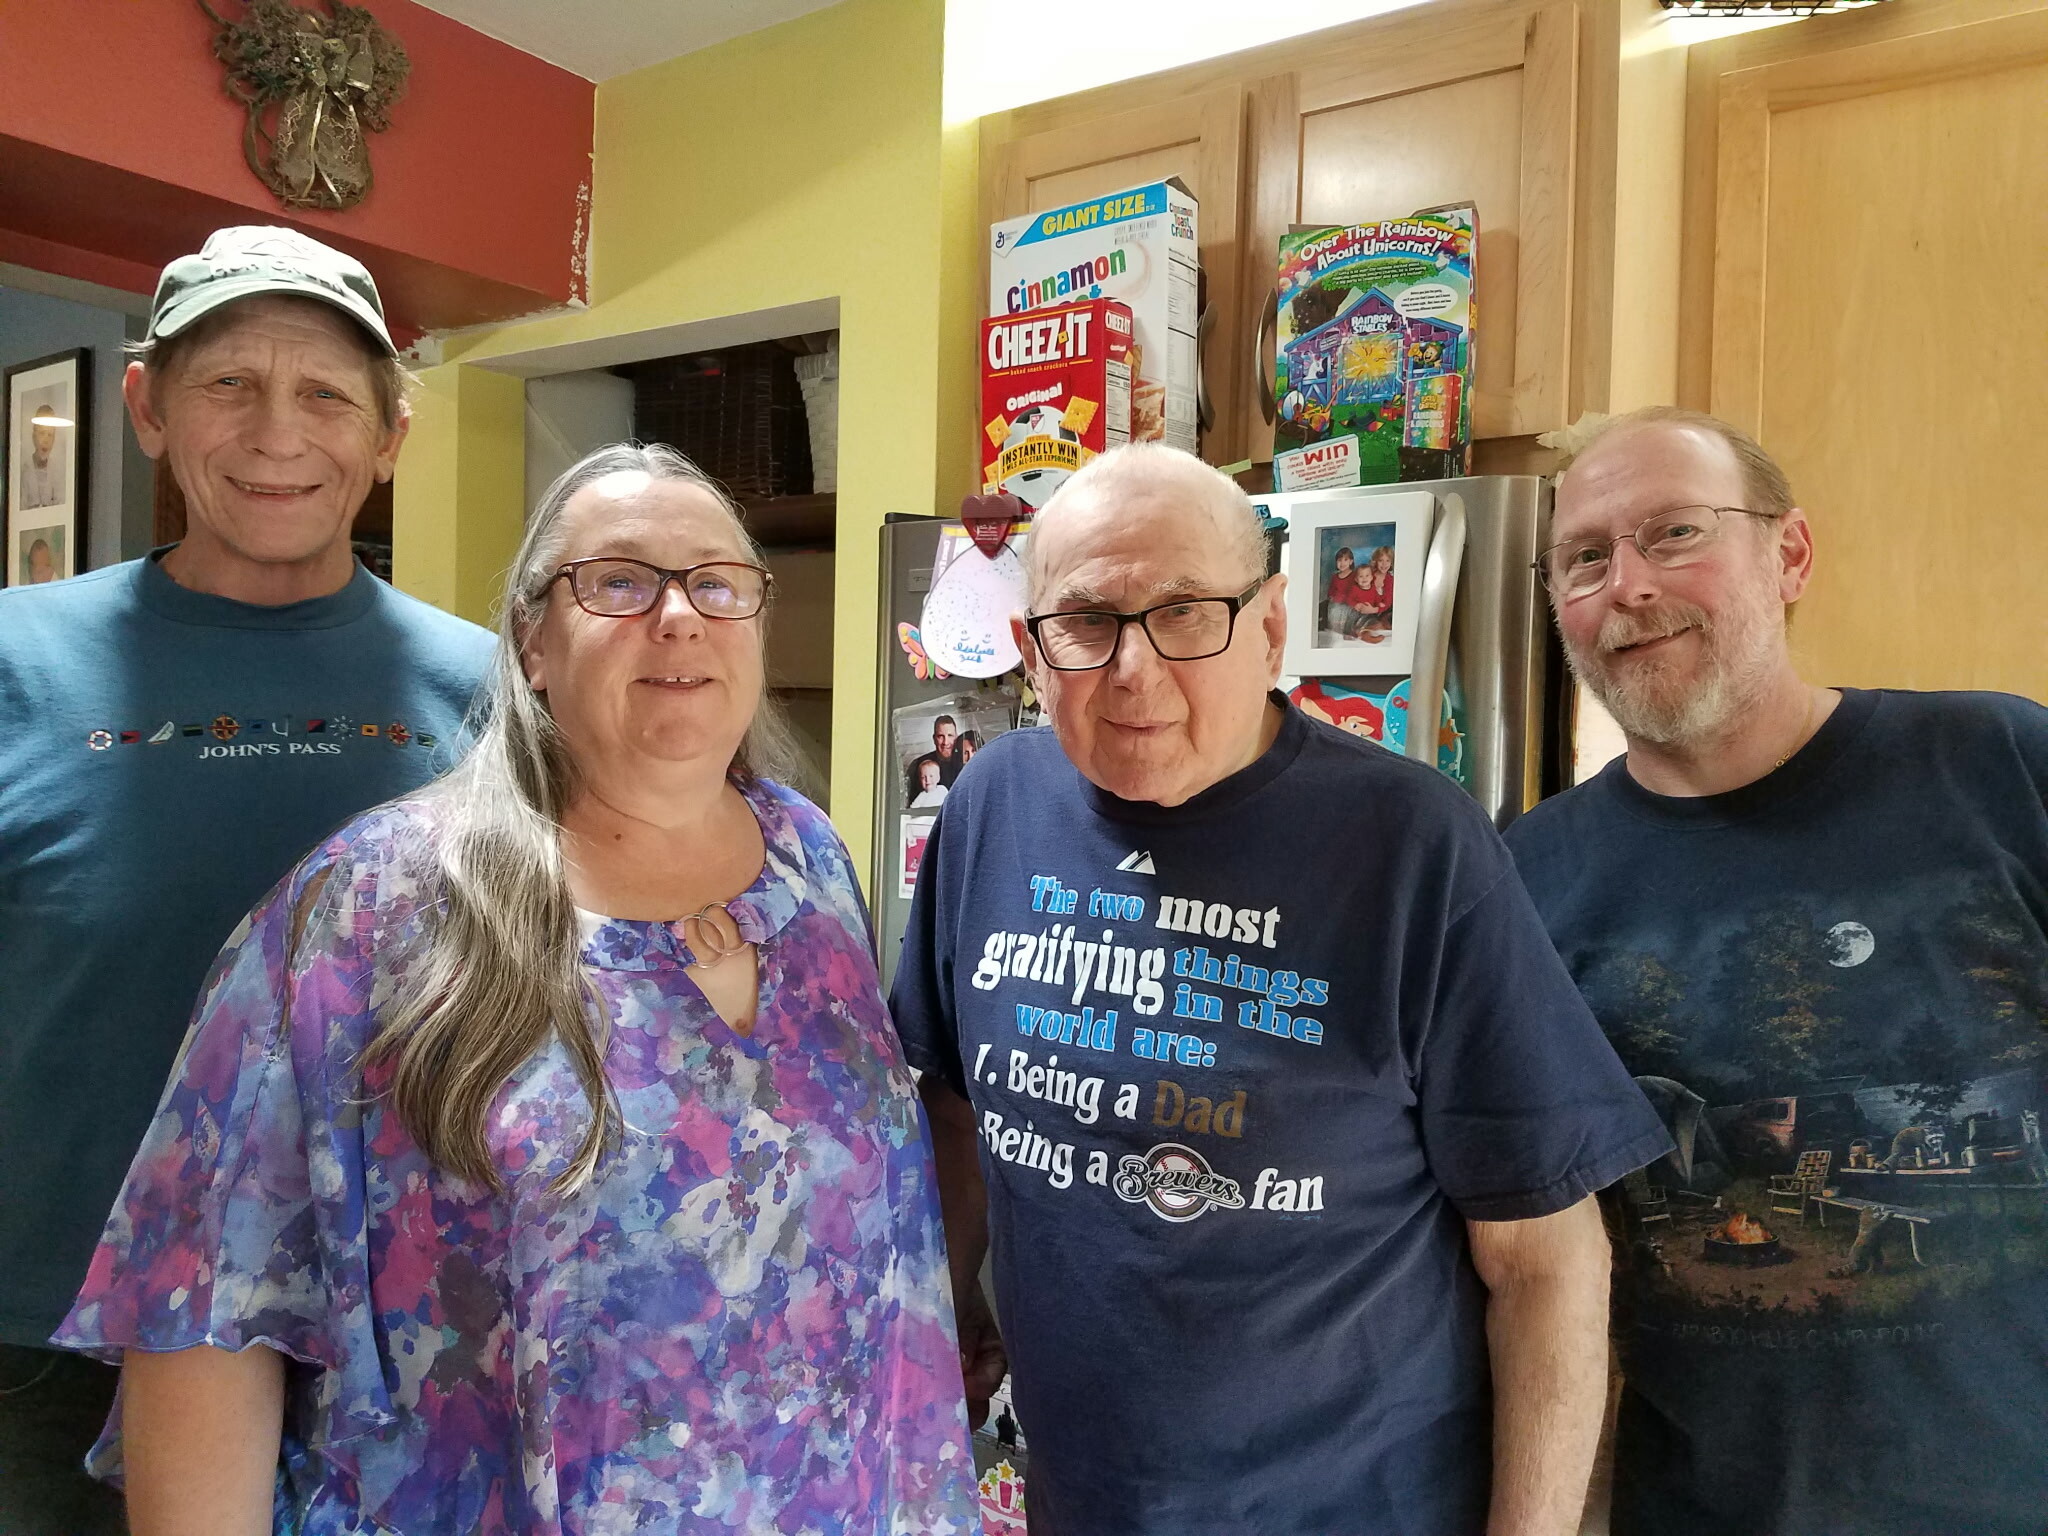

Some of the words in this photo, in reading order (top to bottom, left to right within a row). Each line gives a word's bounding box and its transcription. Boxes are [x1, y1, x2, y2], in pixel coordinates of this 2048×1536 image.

[1042, 205, 1100, 235] GIANT
[1103, 193, 1147, 221] SIZE
[1300, 234, 1340, 262] Over
[1344, 225, 1375, 241] The
[1380, 220, 1454, 242] Rainbow
[1007, 248, 1127, 314] Cinnamon
[1317, 243, 1361, 271] About
[1363, 237, 1442, 257] Unicorns!
[1002, 442, 1054, 467] INSTANTLY
[1057, 442, 1078, 459] WIN
[199, 743, 281, 760] JOHN'S
[289, 743, 342, 755] PASS
[1030, 874, 1079, 915] The
[1087, 886, 1146, 921] two
[1155, 895, 1281, 949] most
[971, 923, 1167, 1016] gratifying
[1172, 946, 1330, 1008] things
[1015, 1003, 1119, 1052] world
[1132, 1026, 1219, 1067] are:
[1173, 983, 1224, 1022] in
[1237, 999, 1325, 1046] the
[974, 1043, 997, 1085] 1.
[1007, 1049, 1105, 1125] Being
[1113, 1082, 1140, 1121] a
[1152, 1080, 1247, 1138] Dad
[984, 1110, 1076, 1189] Being
[1085, 1150, 1108, 1187] a
[1113, 1155, 1245, 1209] Brewers
[1249, 1167, 1325, 1212] fan
